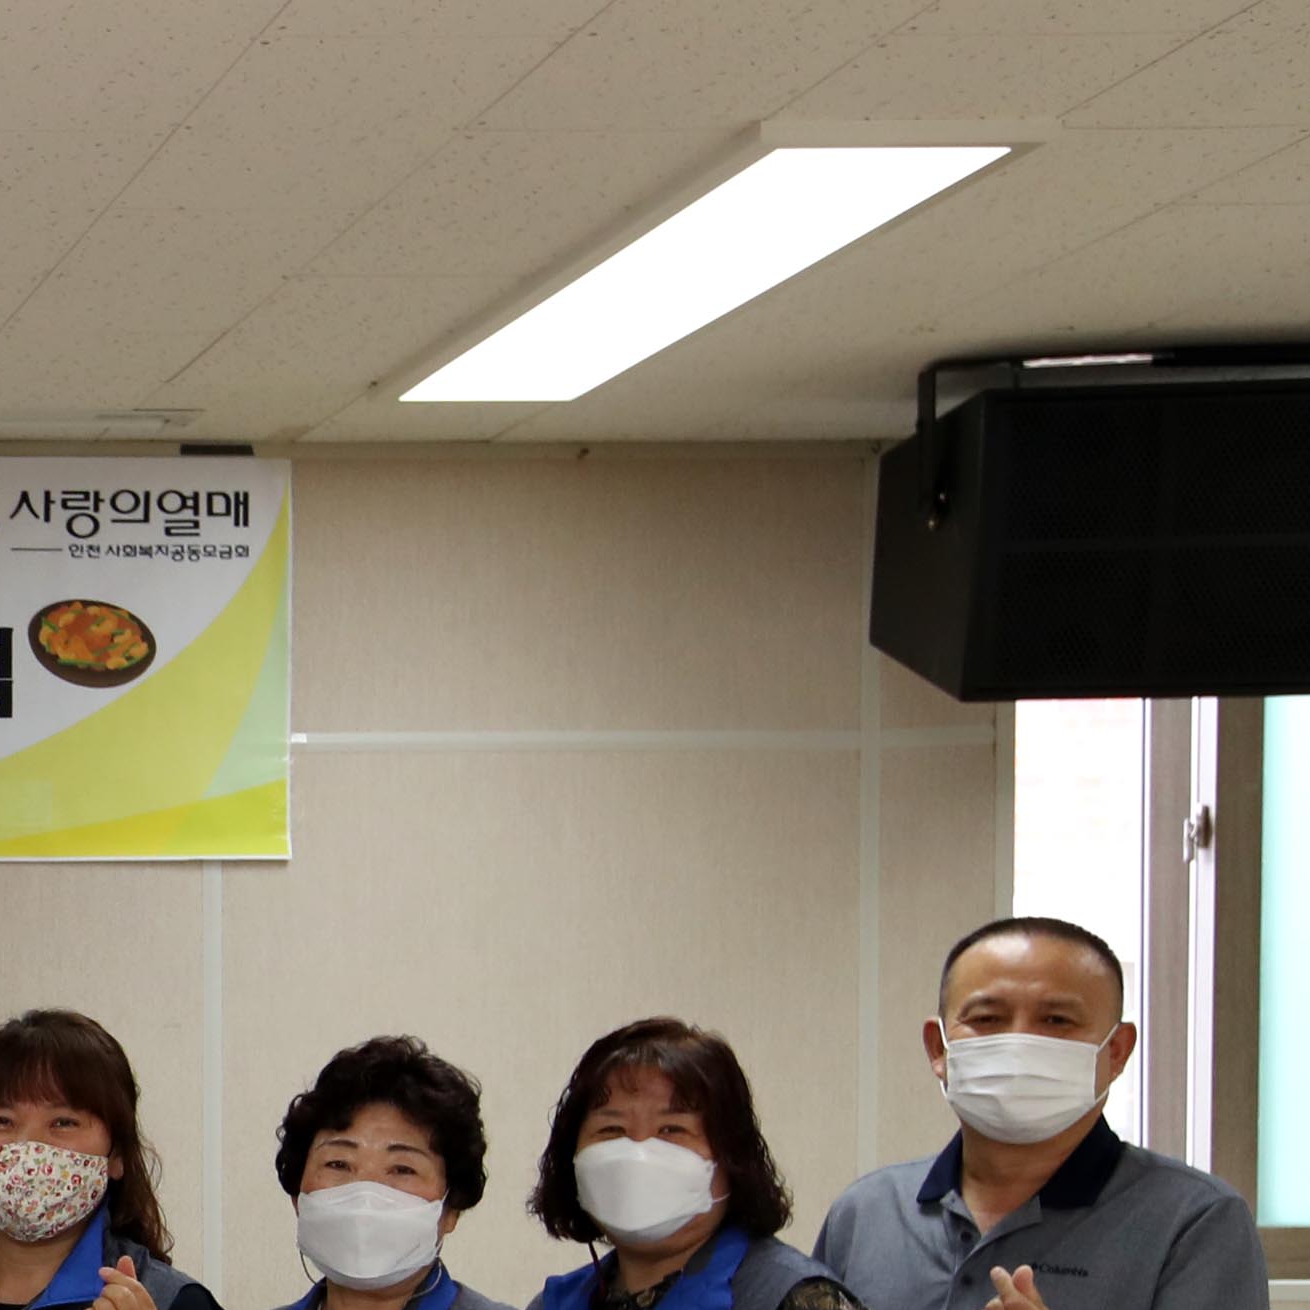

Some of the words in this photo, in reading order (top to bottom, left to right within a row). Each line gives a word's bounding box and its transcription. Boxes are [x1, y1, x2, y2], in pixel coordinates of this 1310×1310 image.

[9, 489, 250, 539] 사랑의열매
[68, 543, 101, 559] 인천
[105, 543, 250, 562] 사회복지공동모금회
